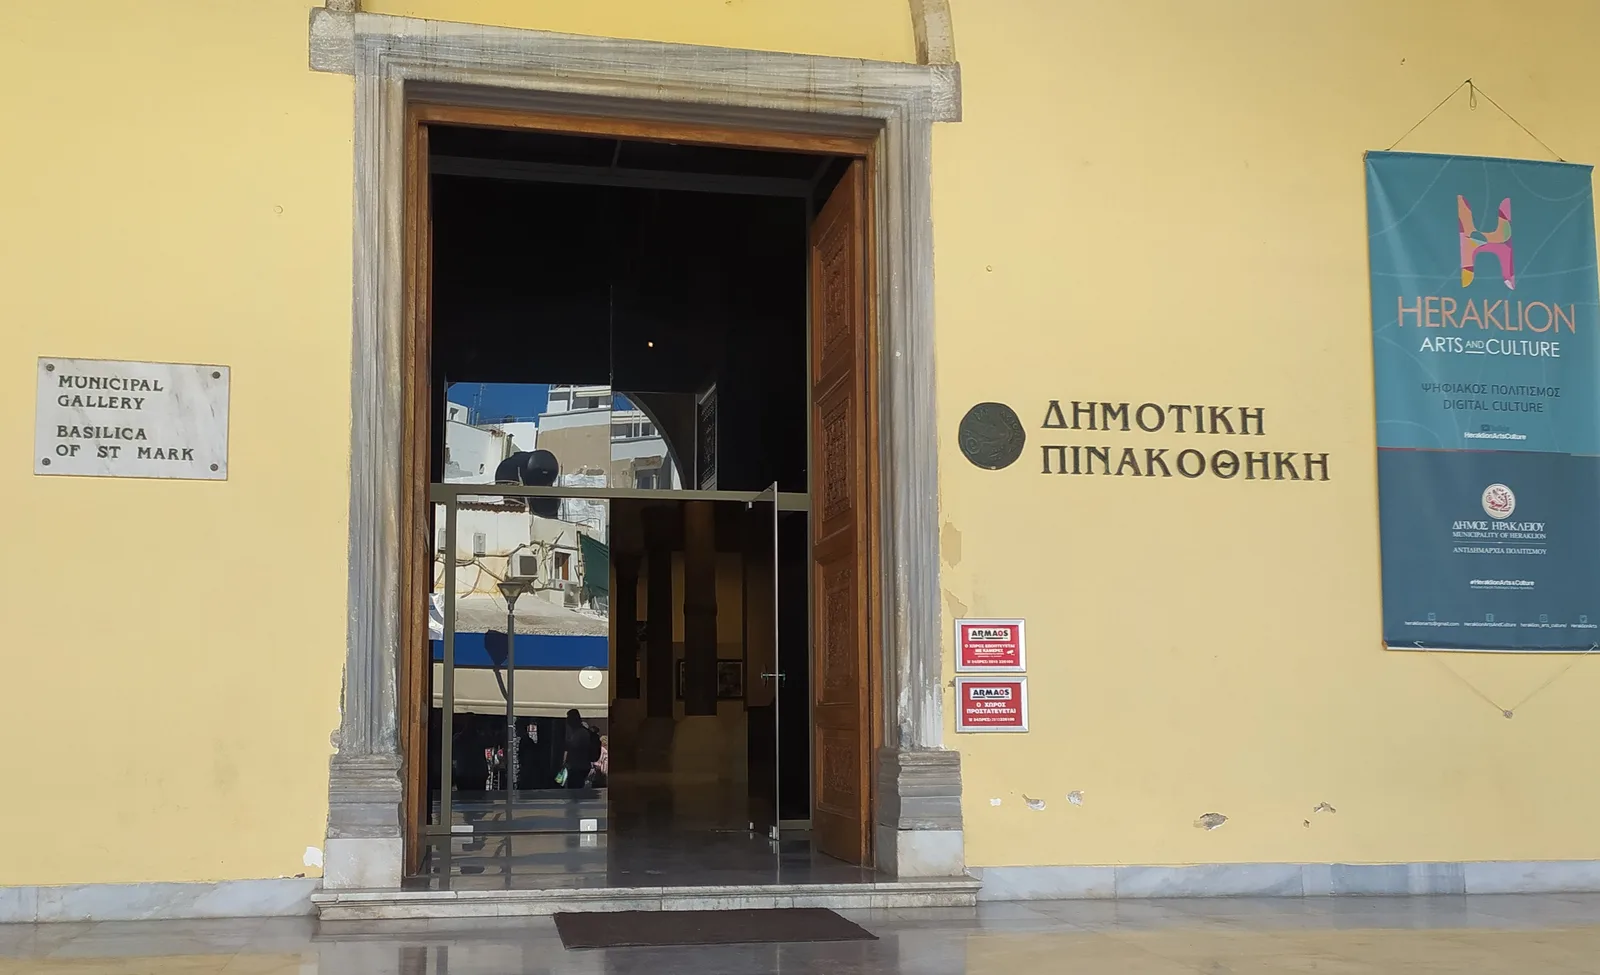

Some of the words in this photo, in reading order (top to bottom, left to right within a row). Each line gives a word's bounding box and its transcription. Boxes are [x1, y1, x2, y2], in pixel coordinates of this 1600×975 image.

[1397, 295, 1576, 335] HERAKLION
[1419, 336, 1464, 354] ARTS
[1465, 340, 1485, 350] AND
[1485, 338, 1561, 358] CULTURE
[58, 375, 164, 392] MUNICIPAL
[1421, 382, 1489, 395] ΨΗΦΙΑΚΟΣ
[1491, 384, 1561, 398] ΠΟΛΙΤΙΣΜΟΣ
[57, 394, 145, 410] GALLERY
[1443, 399, 1489, 411] DIGITAL
[1492, 401, 1544, 413] CULTURE
[1040, 399, 1267, 437] ΔΗΜΟΤΙΚΗ
[56, 425, 148, 441] BASILICA
[55, 444, 81, 458] OF
[96, 446, 121, 460] ST
[136, 447, 195, 461] MARK
[1040, 445, 1332, 482] ΠΙΝΑΚΟΘΗΚΗ
[1452, 520, 1489, 531] ΔΗΜΟΣ
[1491, 521, 1546, 533] ΗΡΑΚΛΕΙΟΥ
[1452, 531, 1499, 539] MUNICIPALITY
[1510, 532, 1547, 540] HERAKLION
[971, 629, 1009, 638] ARMAOS
[973, 689, 1010, 697] ARMAOS
